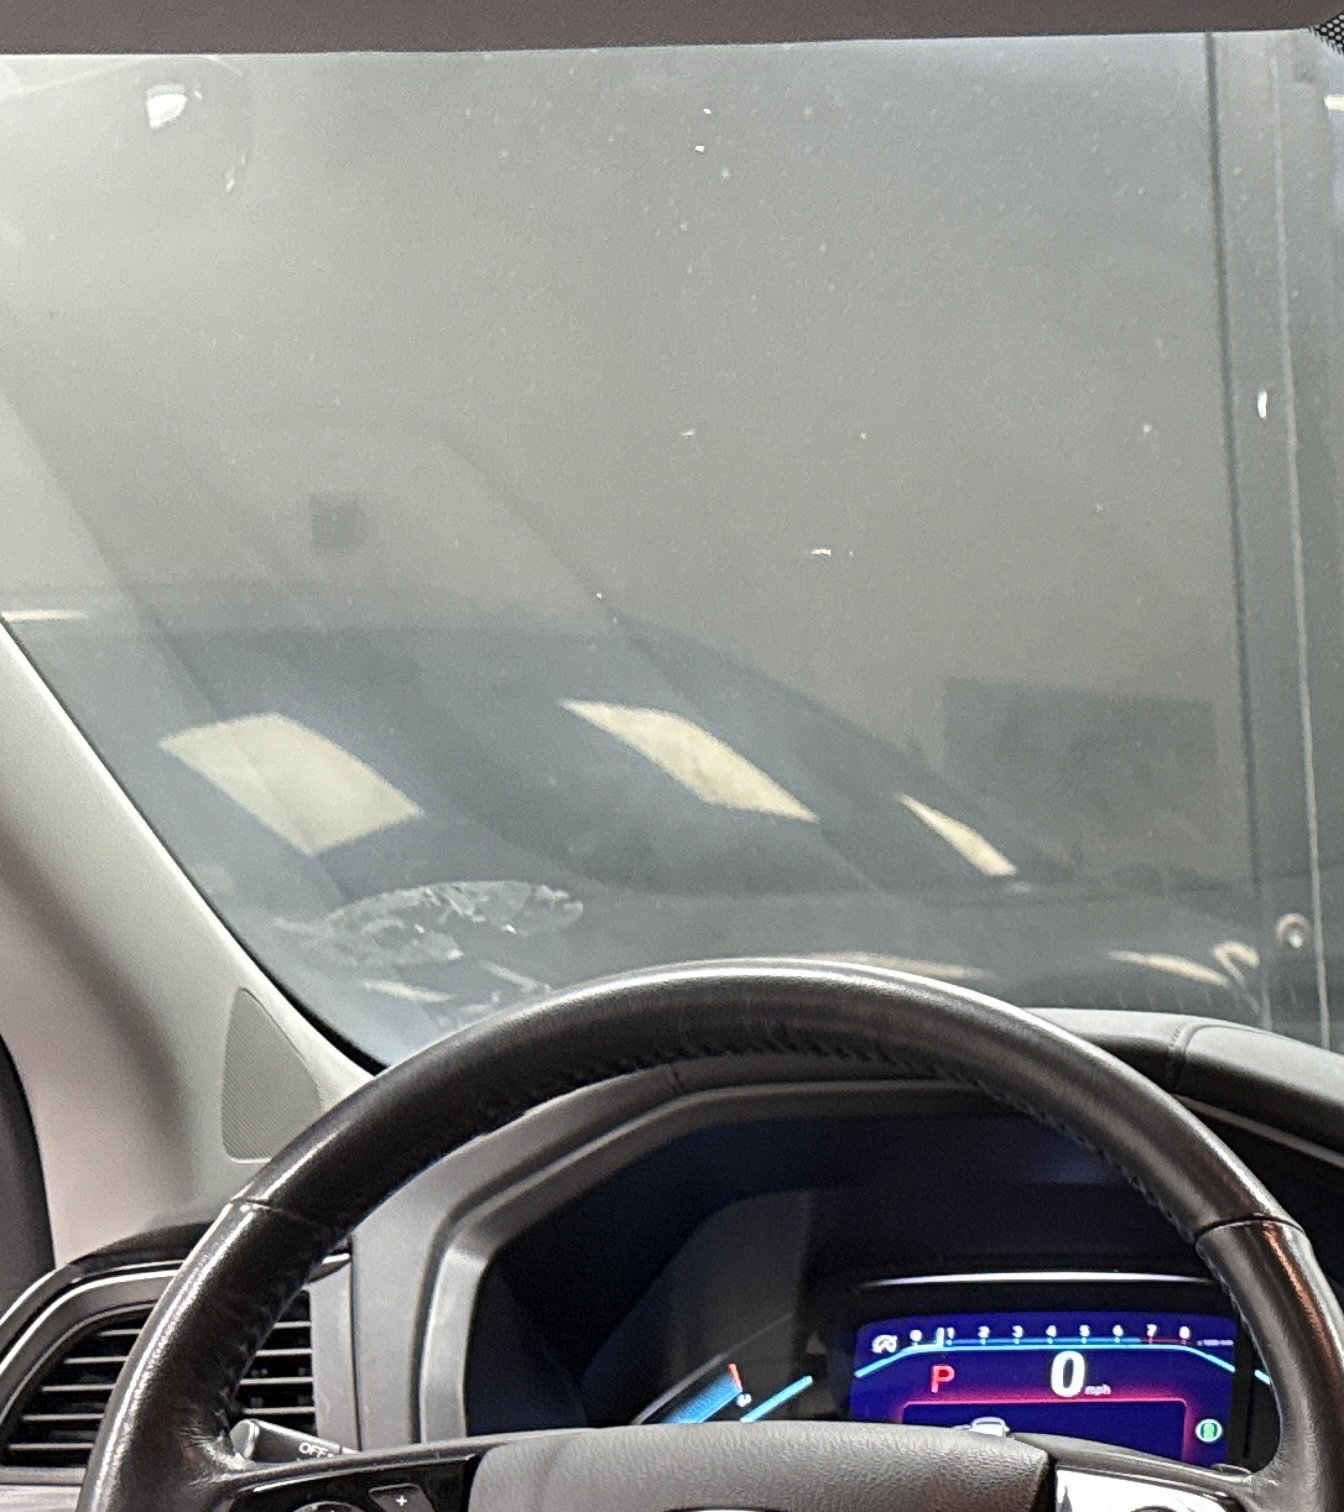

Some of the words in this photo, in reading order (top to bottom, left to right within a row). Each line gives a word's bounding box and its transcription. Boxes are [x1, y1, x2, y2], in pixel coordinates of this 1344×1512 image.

[946, 1327, 955, 1339] 1
[978, 1325, 990, 1338] 2
[1012, 1325, 1023, 1337] 3
[1045, 1325, 1057, 1337] 4
[1079, 1324, 1090, 1336] 5
[1112, 1324, 1123, 1336] 6
[1146, 1324, 1157, 1336] 7
[931, 1365, 955, 1393] P
[1051, 1351, 1086, 1397] 0
[1085, 1384, 1112, 1396] mph
[299, 1442, 328, 1459] OFF
